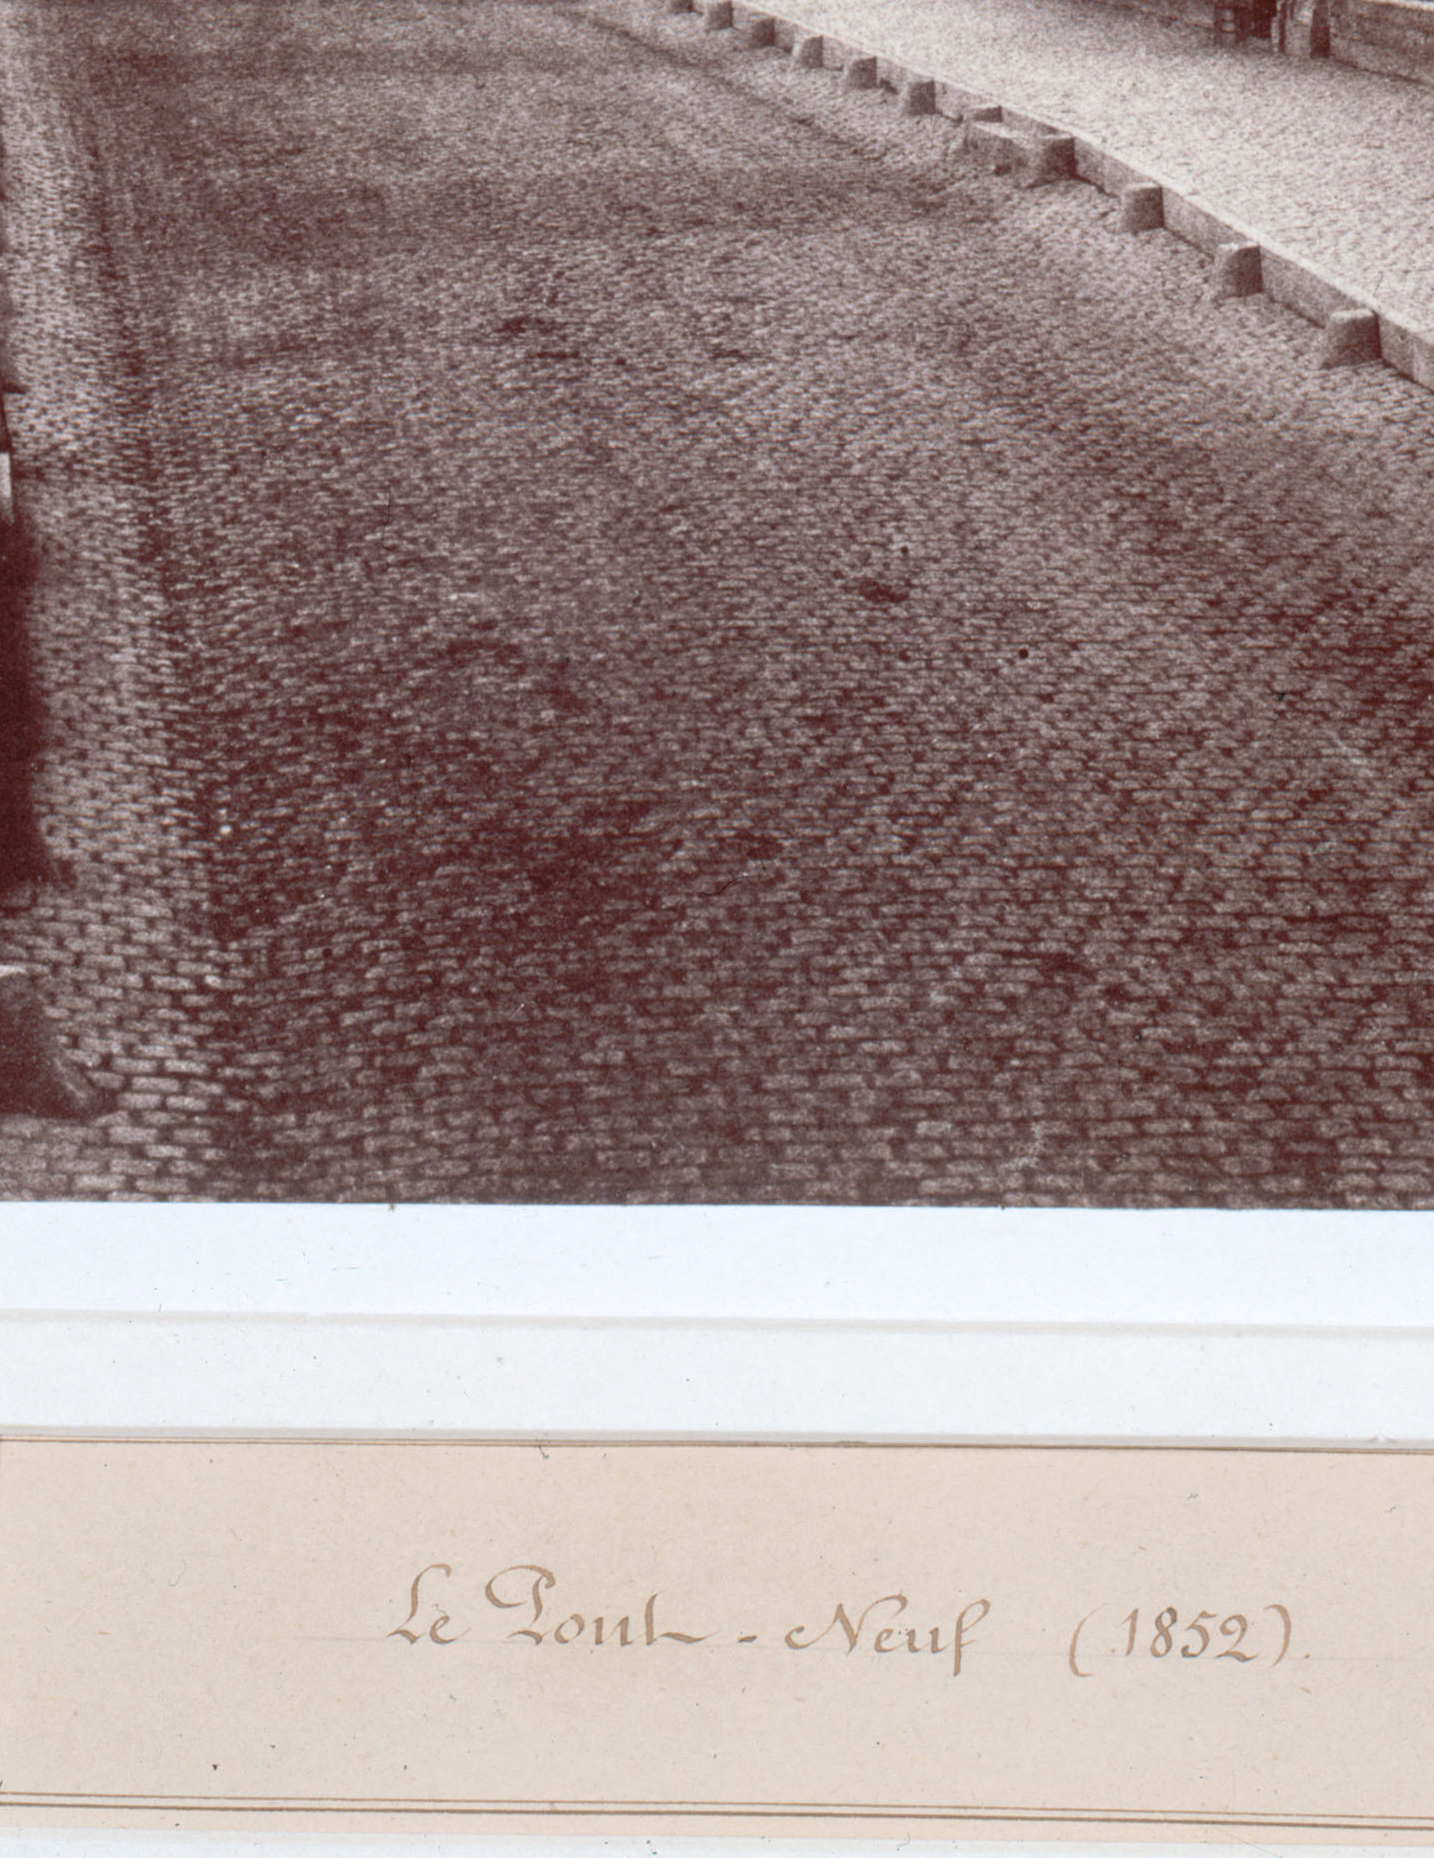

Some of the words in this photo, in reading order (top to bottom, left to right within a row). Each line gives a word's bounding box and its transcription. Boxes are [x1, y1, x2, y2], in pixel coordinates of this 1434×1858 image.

[386, 1563, 471, 1646] Le
[484, 1564, 721, 1646] Pont
[784, 1594, 1001, 1677] Neuf
